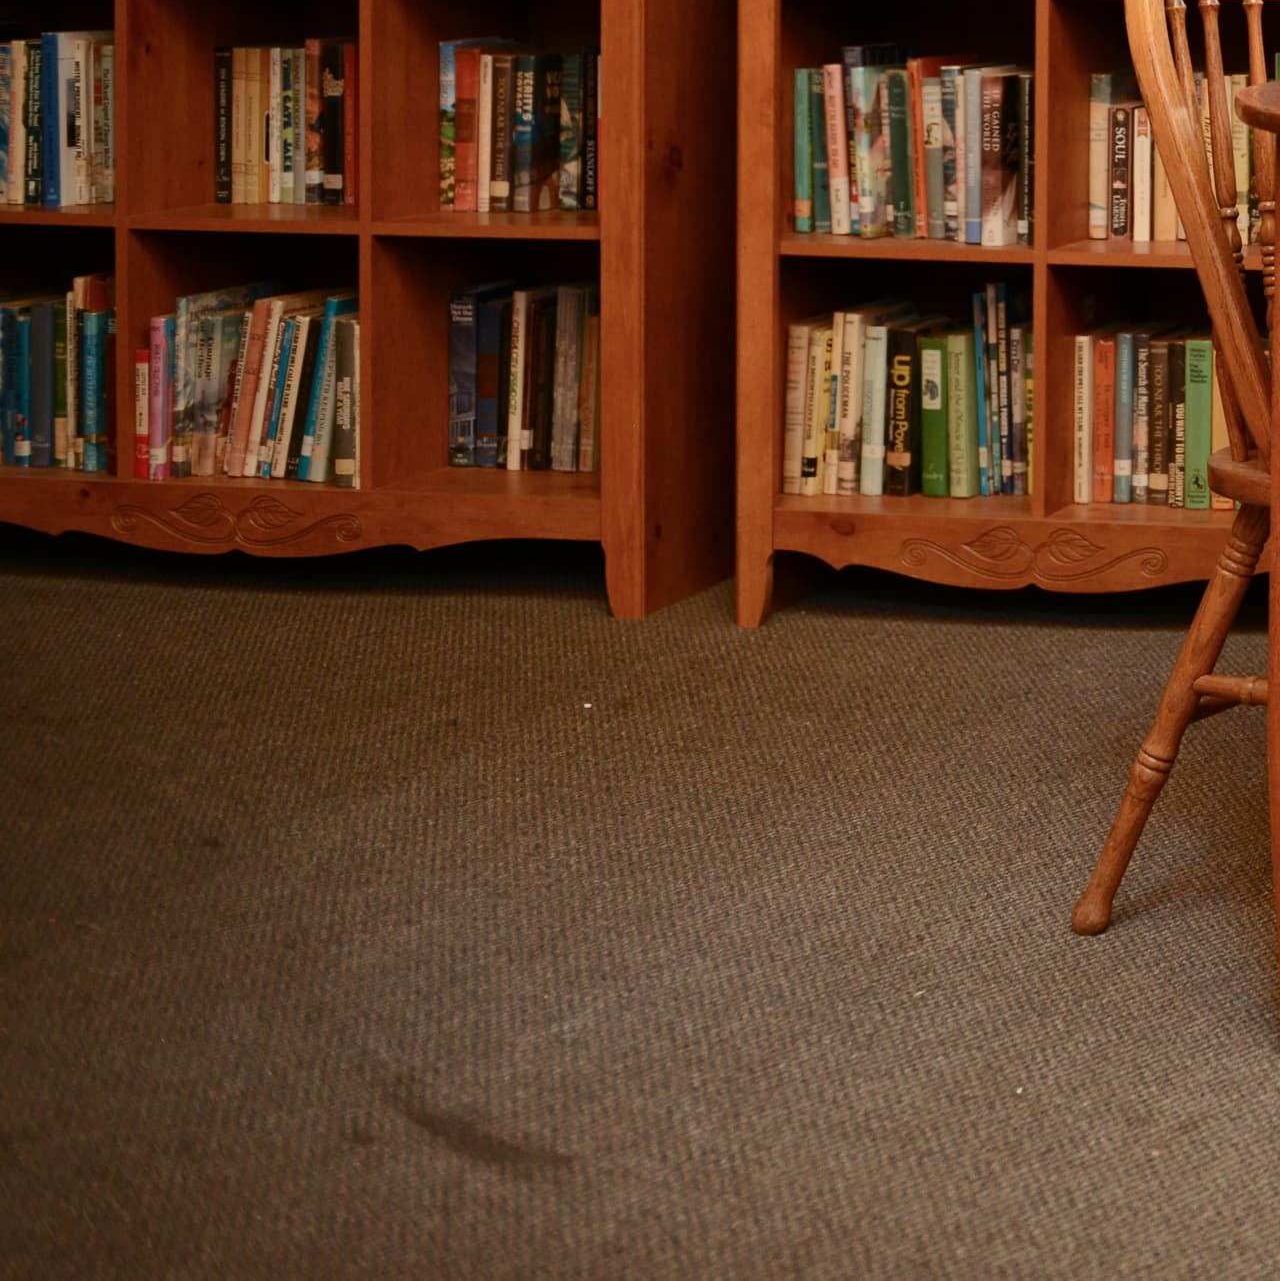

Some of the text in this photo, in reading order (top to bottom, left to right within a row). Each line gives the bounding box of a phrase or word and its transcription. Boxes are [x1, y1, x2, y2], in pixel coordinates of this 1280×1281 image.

[983, 113, 992, 152] WORLD
[991, 111, 1001, 153] GAINED
[586, 139, 596, 193] STANDOFF
[842, 370, 852, 419] POLICEMAN
[894, 388, 910, 419] from
[892, 421, 910, 470] Povey
